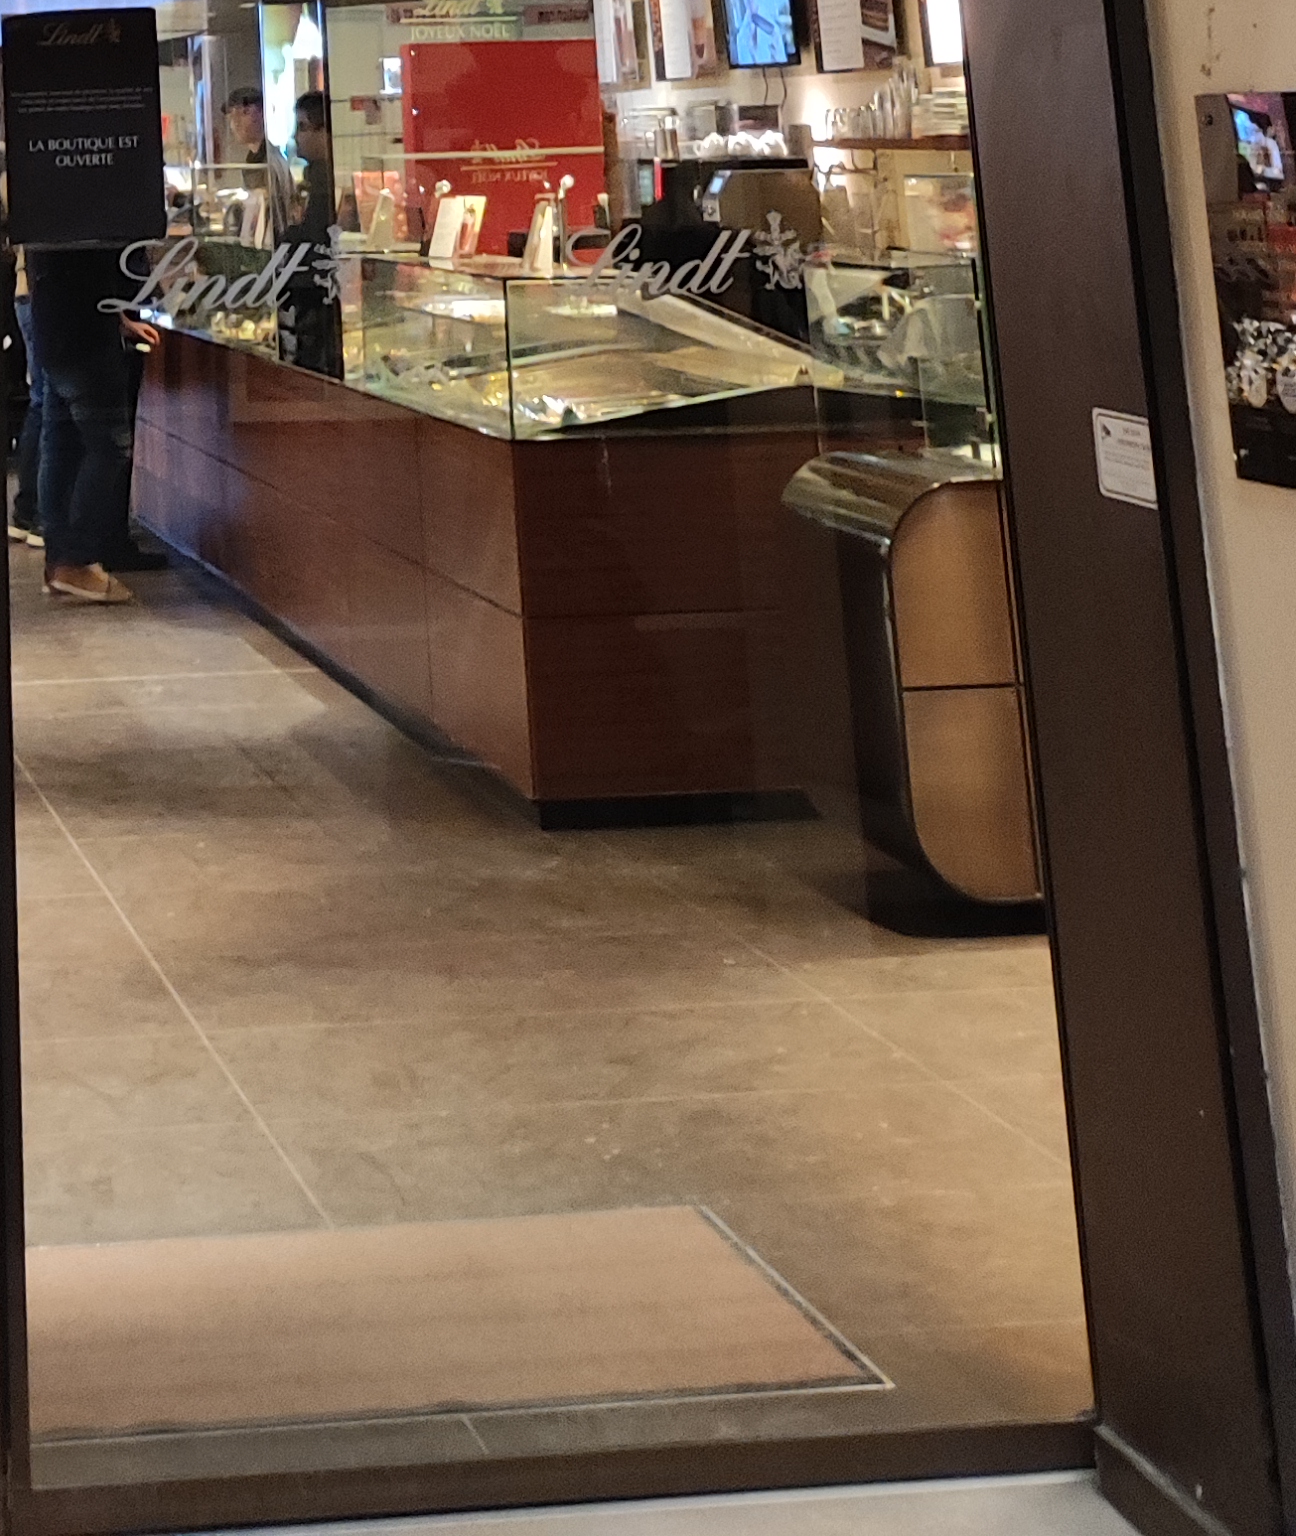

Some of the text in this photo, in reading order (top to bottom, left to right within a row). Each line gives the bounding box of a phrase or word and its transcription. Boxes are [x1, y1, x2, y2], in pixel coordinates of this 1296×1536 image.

[36, 23, 104, 47] Lindt
[411, 25, 466, 41] JOYEUX
[29, 135, 139, 152] LA BOUTIQUE EST
[55, 152, 114, 167] OUVERTE
[546, 223, 752, 300] Lindt
[96, 236, 312, 314] Lindt
